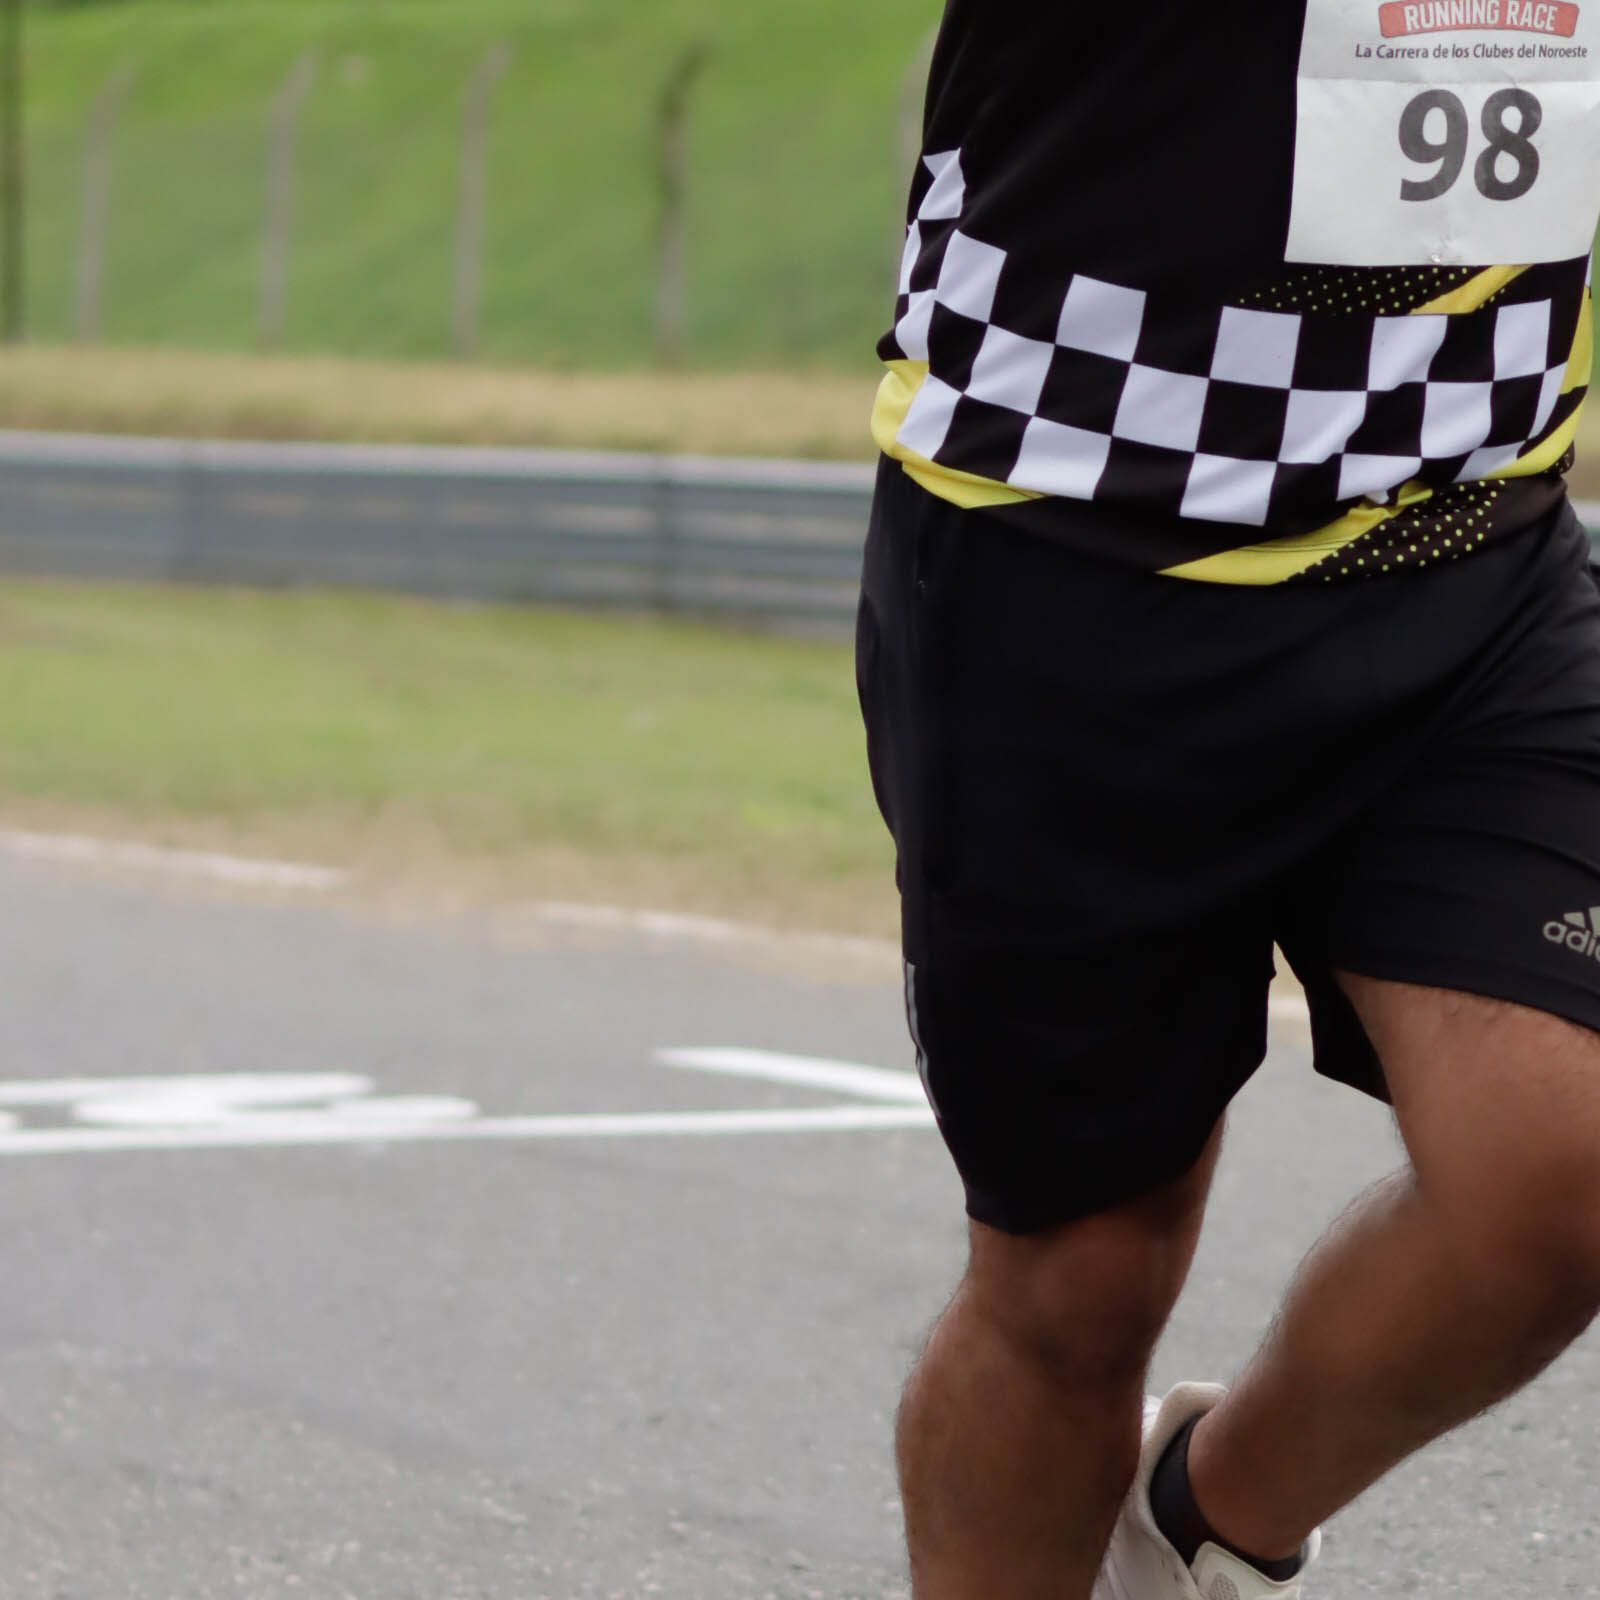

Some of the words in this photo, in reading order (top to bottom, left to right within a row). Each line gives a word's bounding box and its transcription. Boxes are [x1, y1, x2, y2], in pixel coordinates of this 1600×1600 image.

[1505, 1, 1558, 32] RACE
[1355, 43, 1372, 58] La
[1376, 43, 1429, 59] Carrera
[1433, 43, 1449, 58] de
[1452, 43, 1470, 58] los
[1473, 43, 1514, 59] Clubes
[1517, 43, 1536, 58] del
[1539, 43, 1588, 59] Noroeste
[1398, 88, 1543, 201] 98
